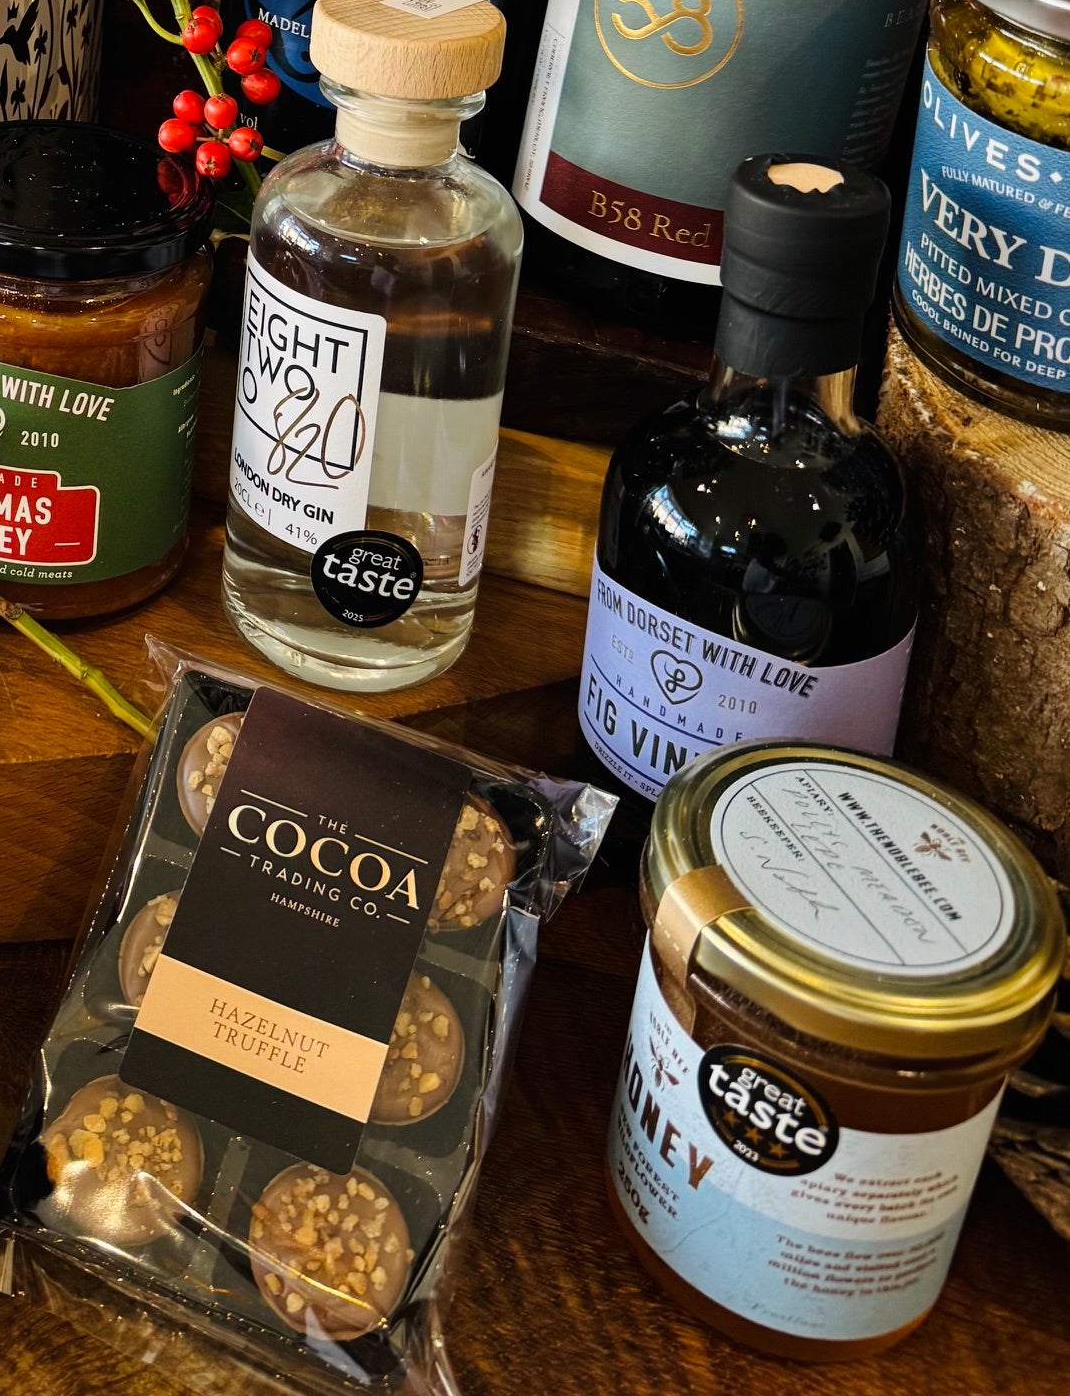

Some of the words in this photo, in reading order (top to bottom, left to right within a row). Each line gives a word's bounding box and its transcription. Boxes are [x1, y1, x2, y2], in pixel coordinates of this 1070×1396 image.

[923, 80, 1041, 183] OLIVES
[941, 165, 969, 183] FULLY
[971, 174, 1035, 205] MATURED
[1038, 197, 1053, 210] &
[588, 190, 642, 232] B58
[650, 213, 711, 249] Red
[920, 167, 1027, 271] VERY
[904, 240, 967, 322] HERBES
[972, 303, 1010, 343] DE
[921, 232, 971, 286] PITTED
[976, 275, 1053, 320] MIXED
[247, 289, 350, 374] EIGHT
[911, 289, 941, 326] COOOL
[942, 319, 990, 354] BRINED
[993, 346, 1022, 369] FOR
[1025, 359, 1066, 382] DEEP
[242, 367, 258, 405] O
[245, 328, 316, 401] TWO
[1, 374, 55, 410] WITH
[59, 388, 116, 423] LOVE
[20, 429, 60, 449] 2010
[234, 446, 270, 497] LONDON
[271, 486, 301, 513] DRY
[303, 503, 334, 526] GIN
[285, 522, 318, 546] 41%
[350, 546, 403, 573] great
[9, 565, 35, 580] cold
[37, 568, 74, 580] meats
[323, 552, 415, 600] taste
[342, 608, 364, 624] 2025
[597, 578, 623, 618] FROM
[627, 599, 696, 654] DORSET
[702, 638, 756, 680] WITH
[760, 666, 820, 700] LOVE
[586, 672, 618, 736] FIG
[615, 674, 743, 742] HANDMADE
[718, 693, 758, 716] 2010
[594, 740, 623, 777] DRIZZLE
[318, 814, 349, 836] THE
[795, 774, 836, 818] APIARY:
[227, 803, 421, 911] COCOA
[745, 794, 806, 863] BEEKEEPER:
[837, 791, 964, 922] WWW.THENOBLEBEE.COM
[249, 854, 342, 902] TRADING
[350, 895, 381, 919] CO.
[269, 892, 342, 928] HAMPSHIRE
[209, 997, 330, 1059] HAZELNUT
[213, 1020, 307, 1075] TRUFFLE
[708, 1062, 828, 1157] taste
[739, 1065, 807, 1118] great
[633, 1139, 681, 1203] FOREST
[732, 1138, 760, 1164] 2023
[617, 1159, 651, 1226] 250g
